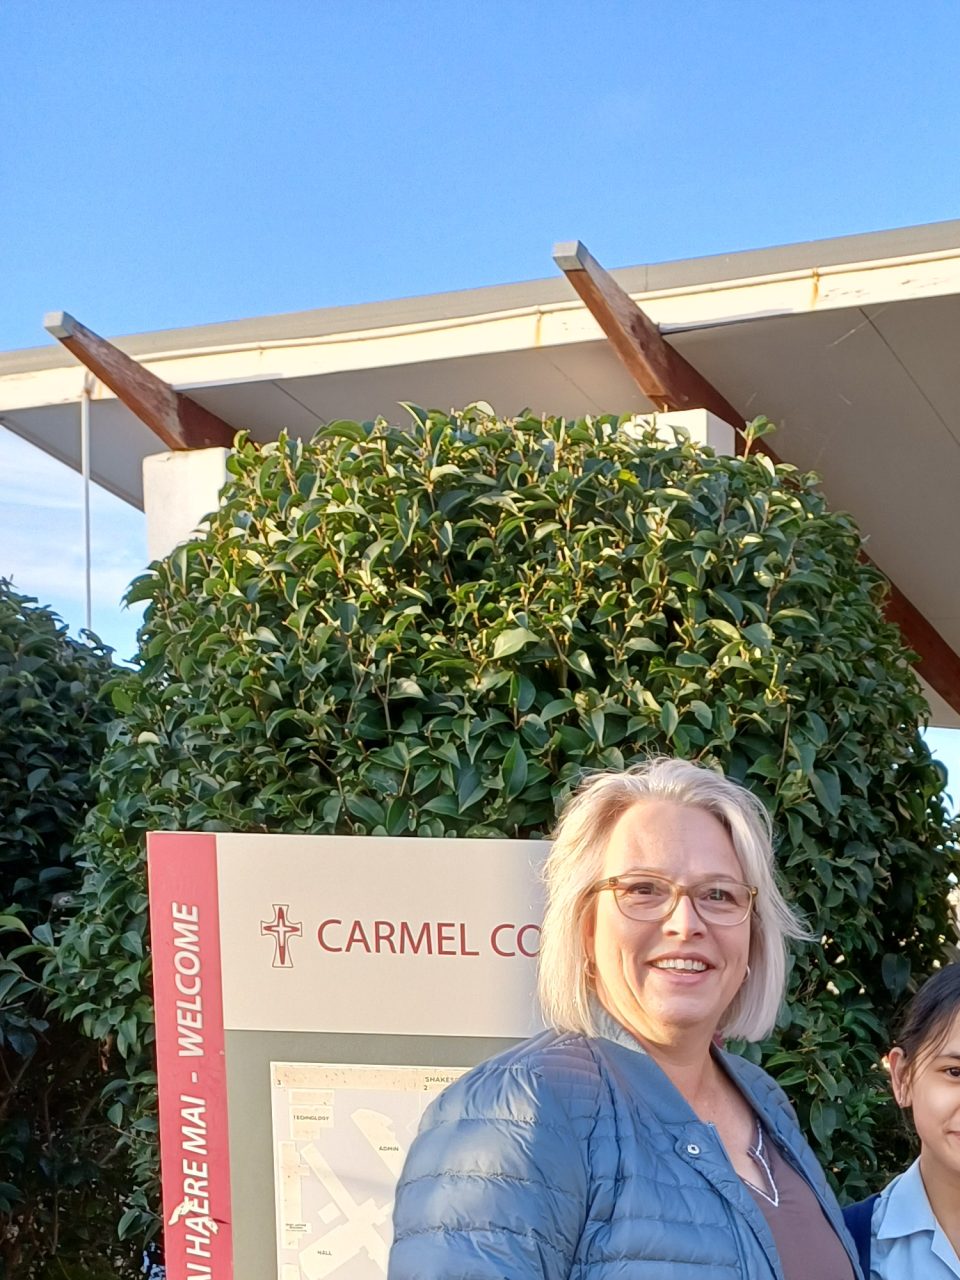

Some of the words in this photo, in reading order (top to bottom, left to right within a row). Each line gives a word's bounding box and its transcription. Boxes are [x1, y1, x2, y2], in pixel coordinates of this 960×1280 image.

[317, 919, 480, 957] CARMEL
[172, 902, 205, 1057] WELCOME
[180, 1094, 208, 1155] MAI
[182, 1158, 213, 1258] HAERE
